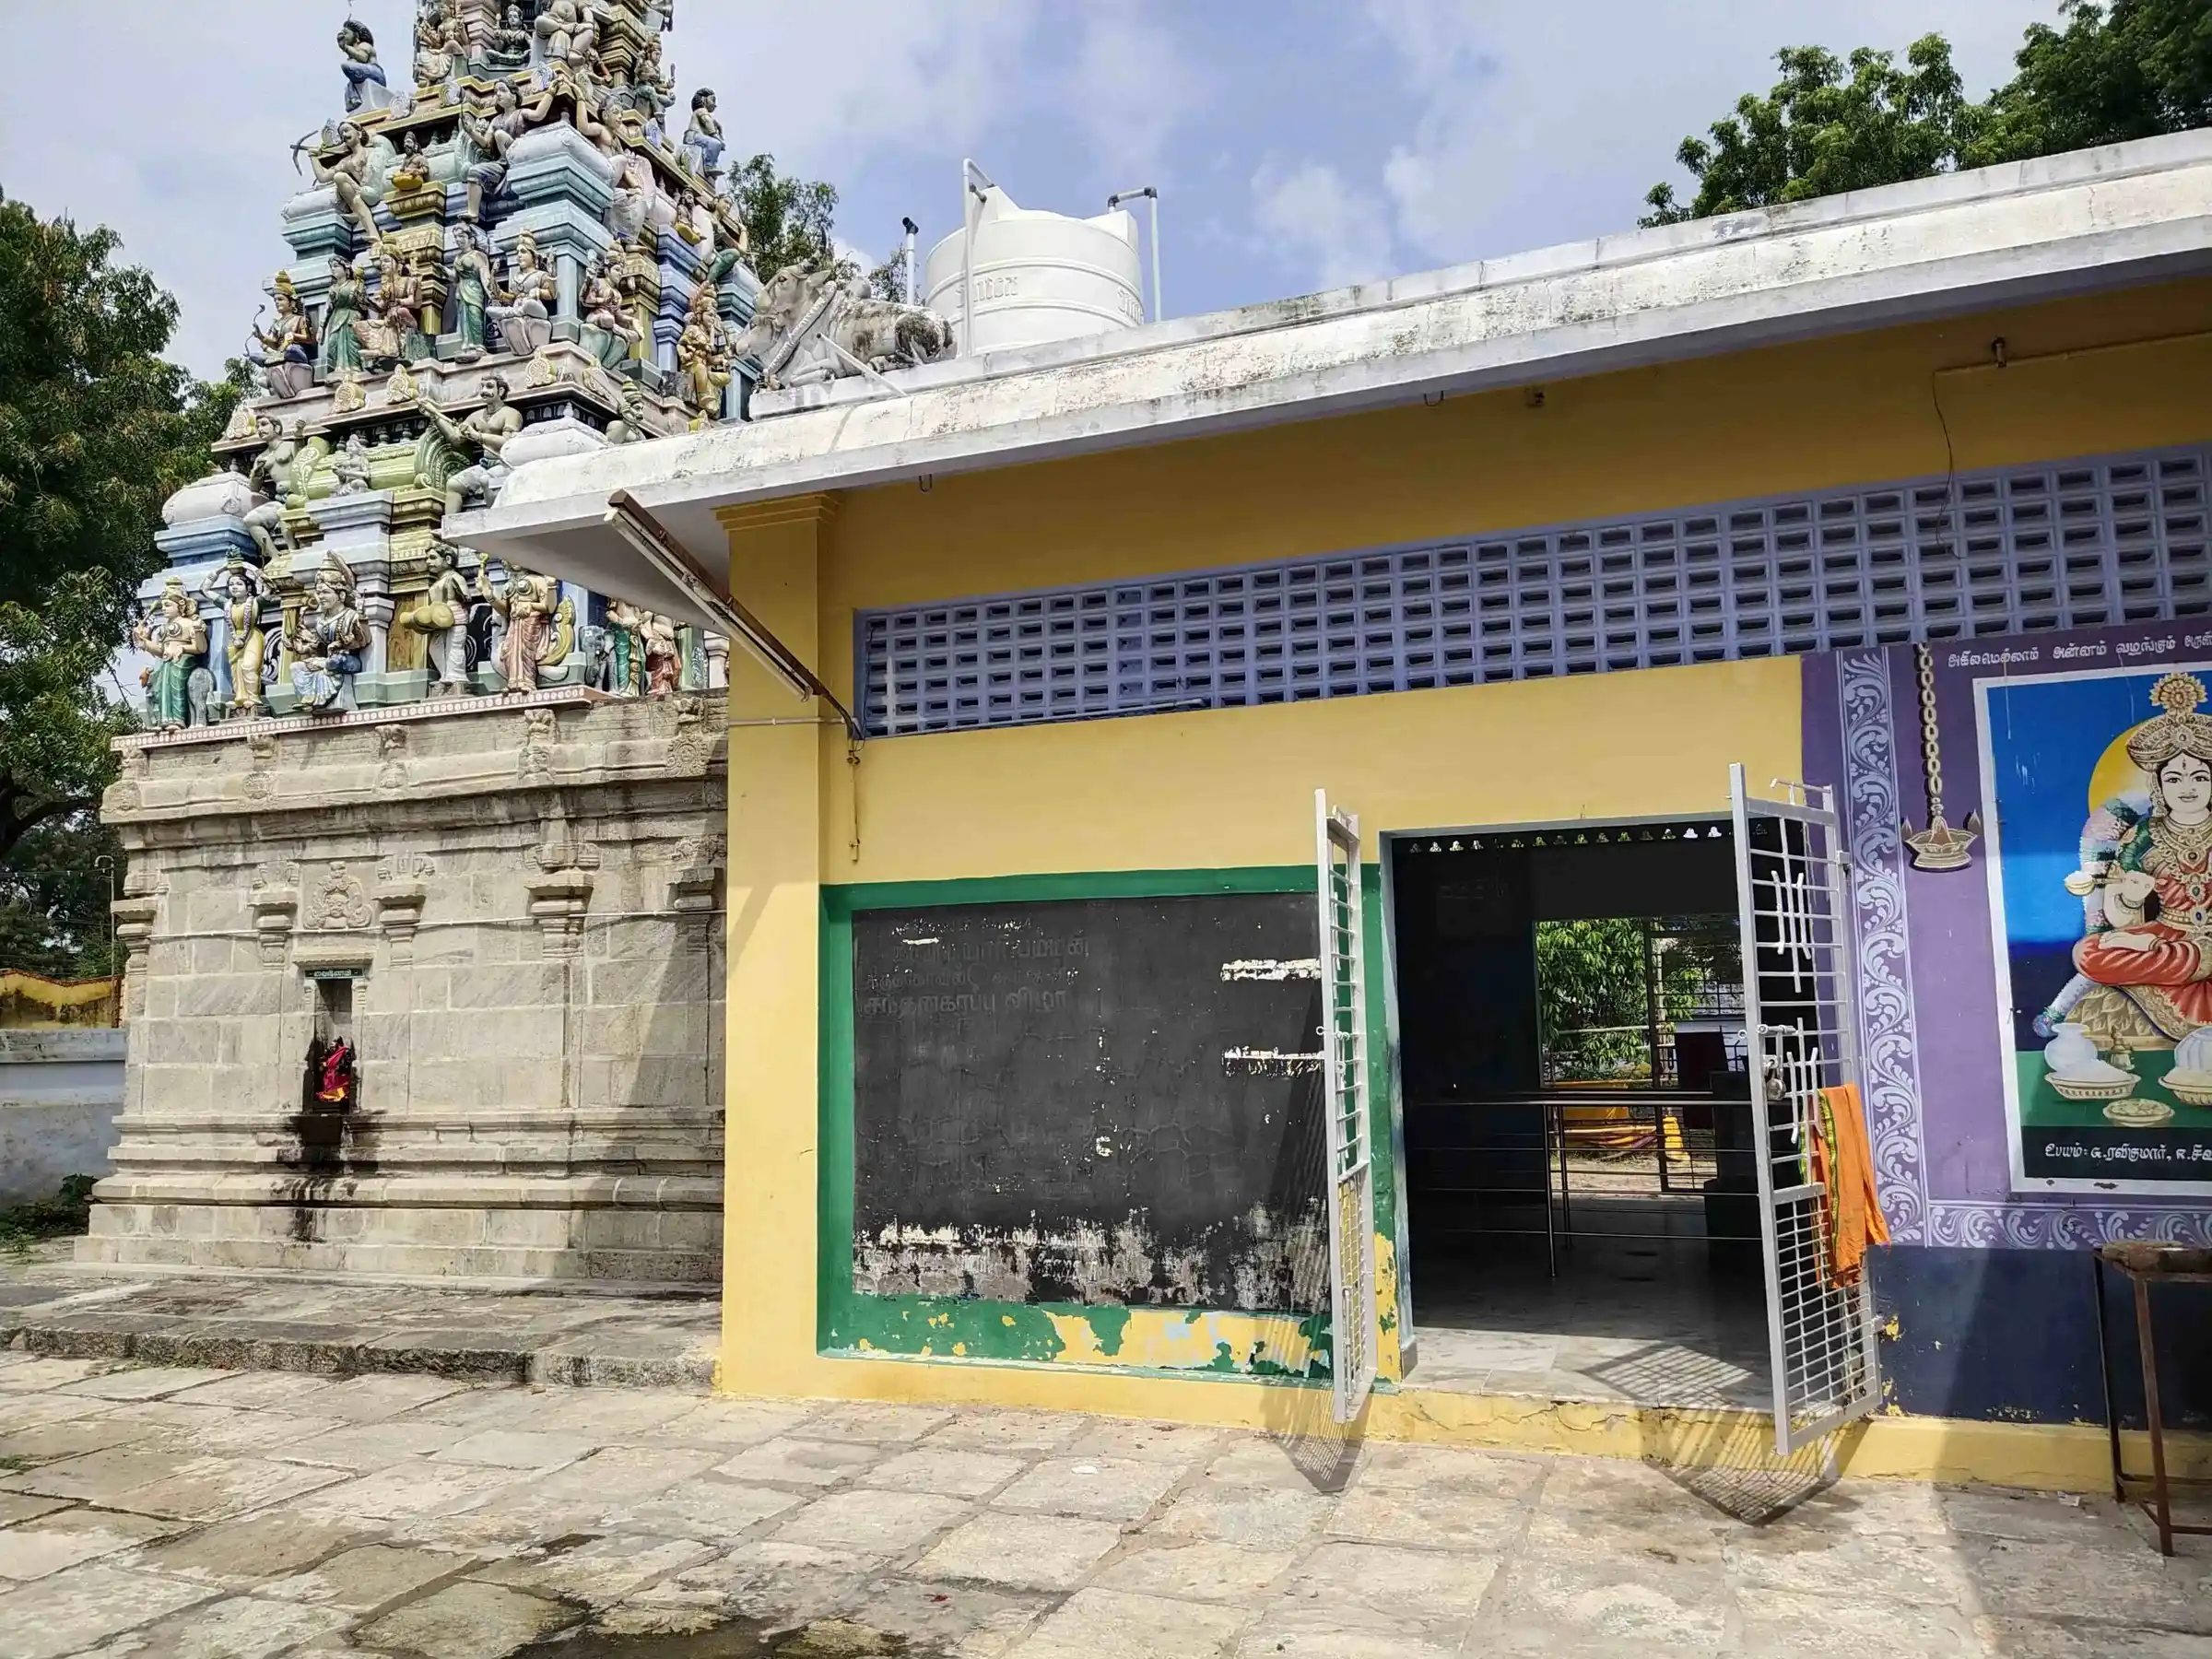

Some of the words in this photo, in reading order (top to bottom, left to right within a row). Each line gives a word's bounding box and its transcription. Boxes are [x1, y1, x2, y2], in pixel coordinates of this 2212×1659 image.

[1947, 647, 2040, 667] அகிலமெல்லாம்
[2053, 640, 2108, 659] அன்னம்
[2115, 634, 2176, 654] வழங்கும்
[2044, 1142, 2088, 1158] உபயம்:
